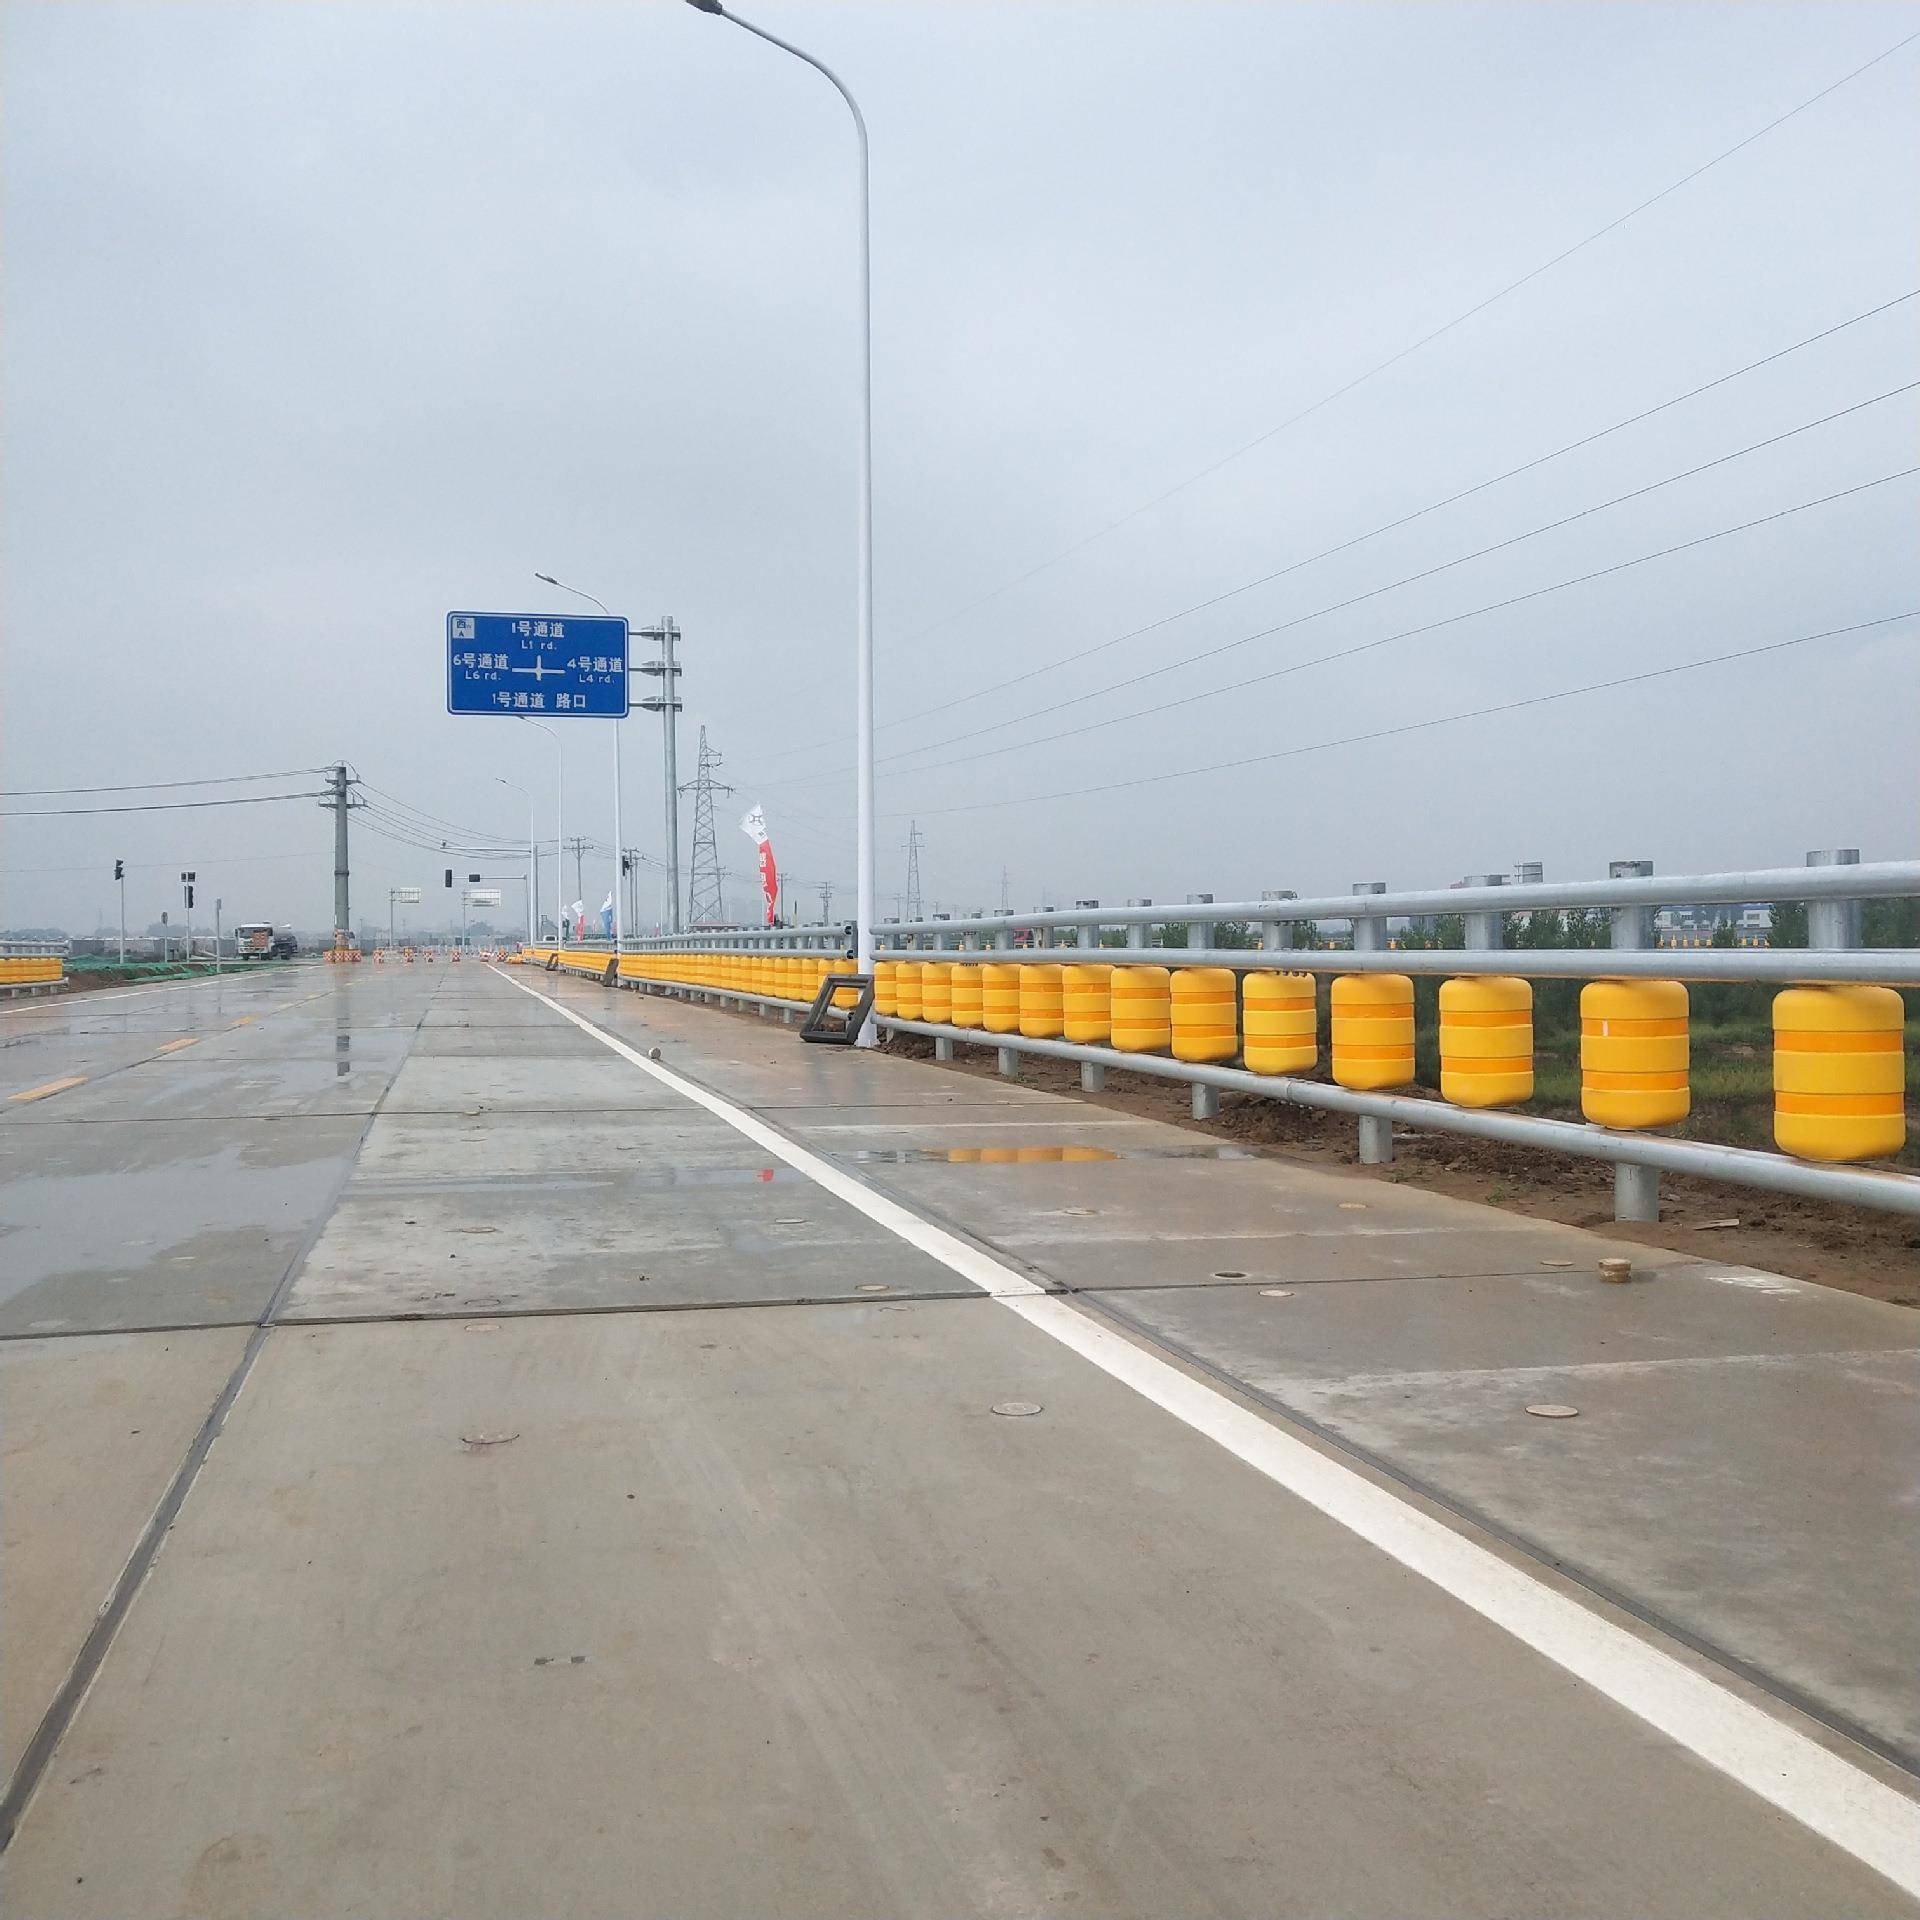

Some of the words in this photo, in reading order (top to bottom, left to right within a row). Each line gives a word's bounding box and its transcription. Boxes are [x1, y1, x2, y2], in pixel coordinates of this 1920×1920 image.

[511, 620, 565, 638] 1号通道
[521, 640, 534, 650] L1
[540, 640, 558, 650] rd.
[453, 652, 509, 670] 6号通道
[566, 656, 624, 673] 4号通道
[465, 670, 480, 680] L6
[484, 670, 502, 681] rd.
[579, 674, 594, 683] L4
[598, 674, 615, 684] rd.
[492, 691, 545, 709] 1号通道
[556, 692, 587, 710] 路口
